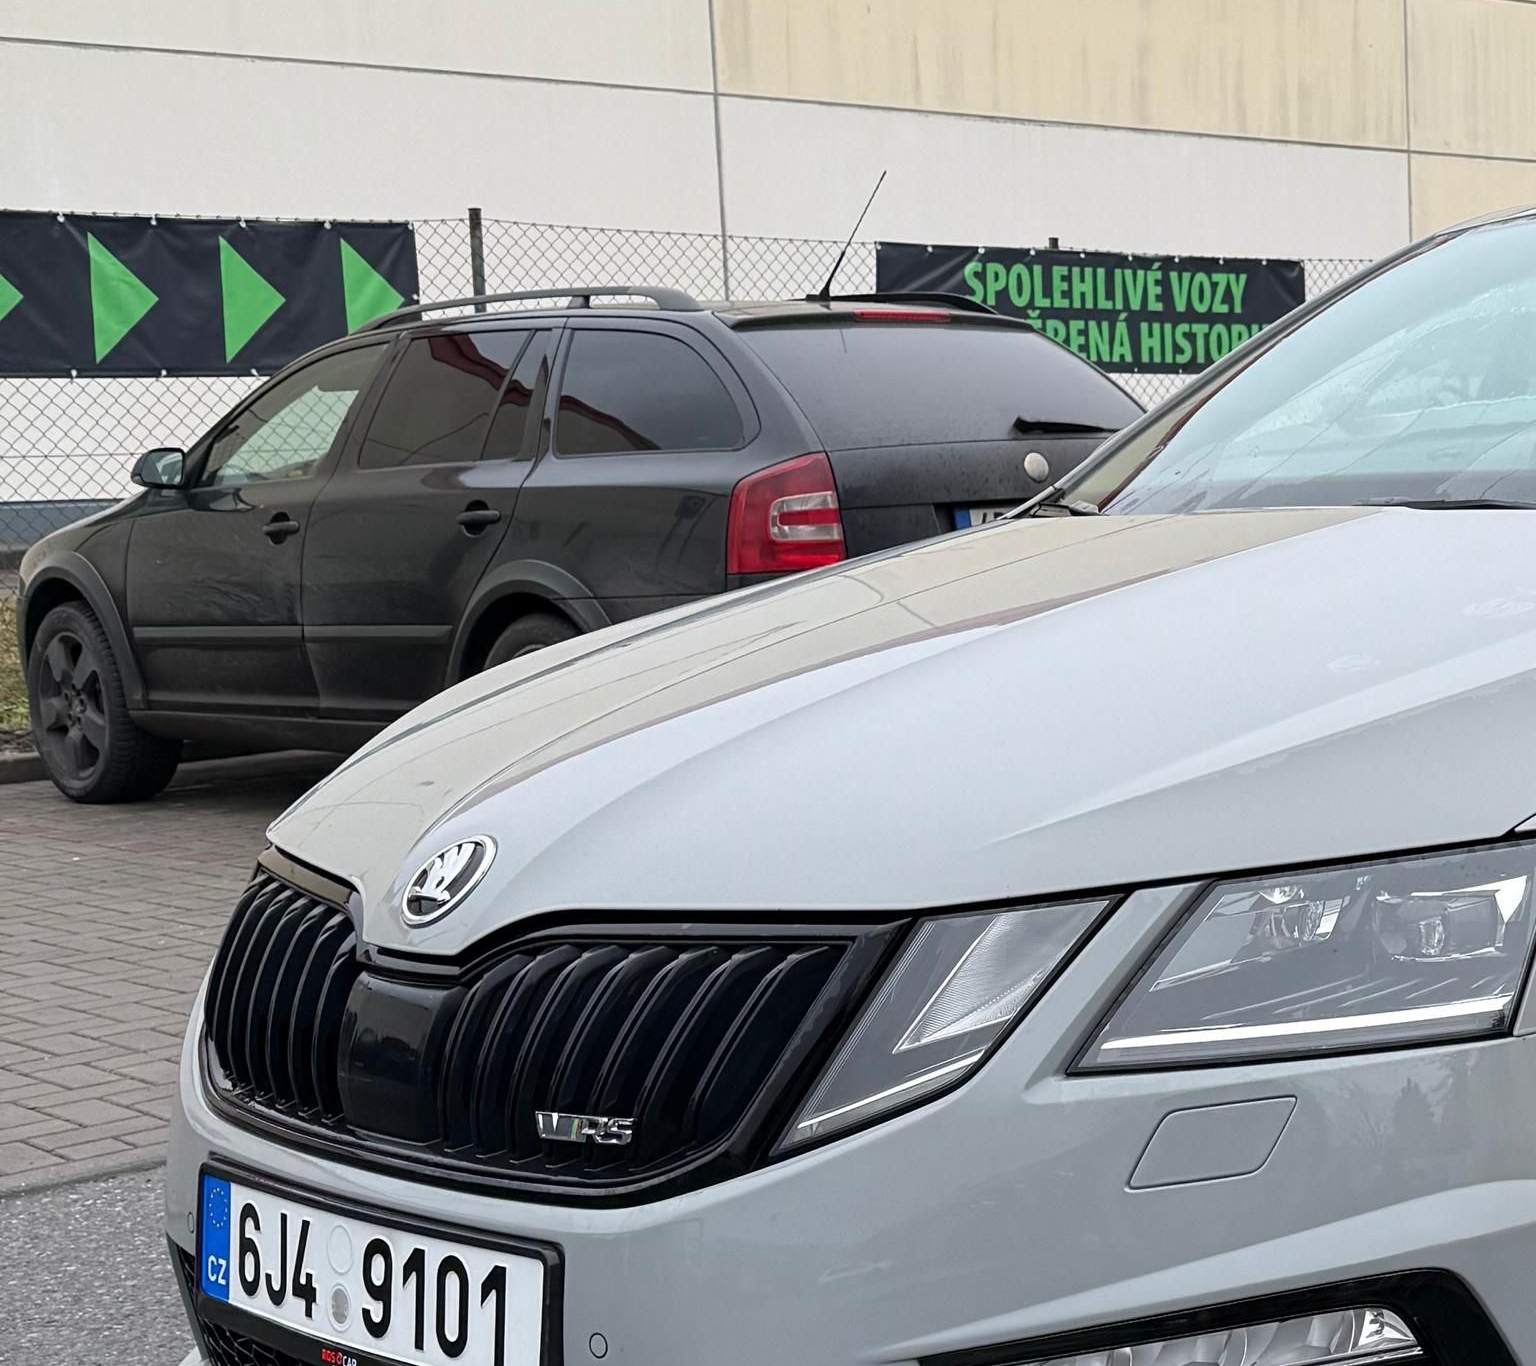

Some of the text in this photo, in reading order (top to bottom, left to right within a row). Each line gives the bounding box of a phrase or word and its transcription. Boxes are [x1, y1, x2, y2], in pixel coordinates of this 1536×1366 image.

[964, 261, 1248, 314] SPOLEHLIVÉ VOZY
[207, 1255, 227, 1285] CZ
[238, 1202, 318, 1320] 6J4
